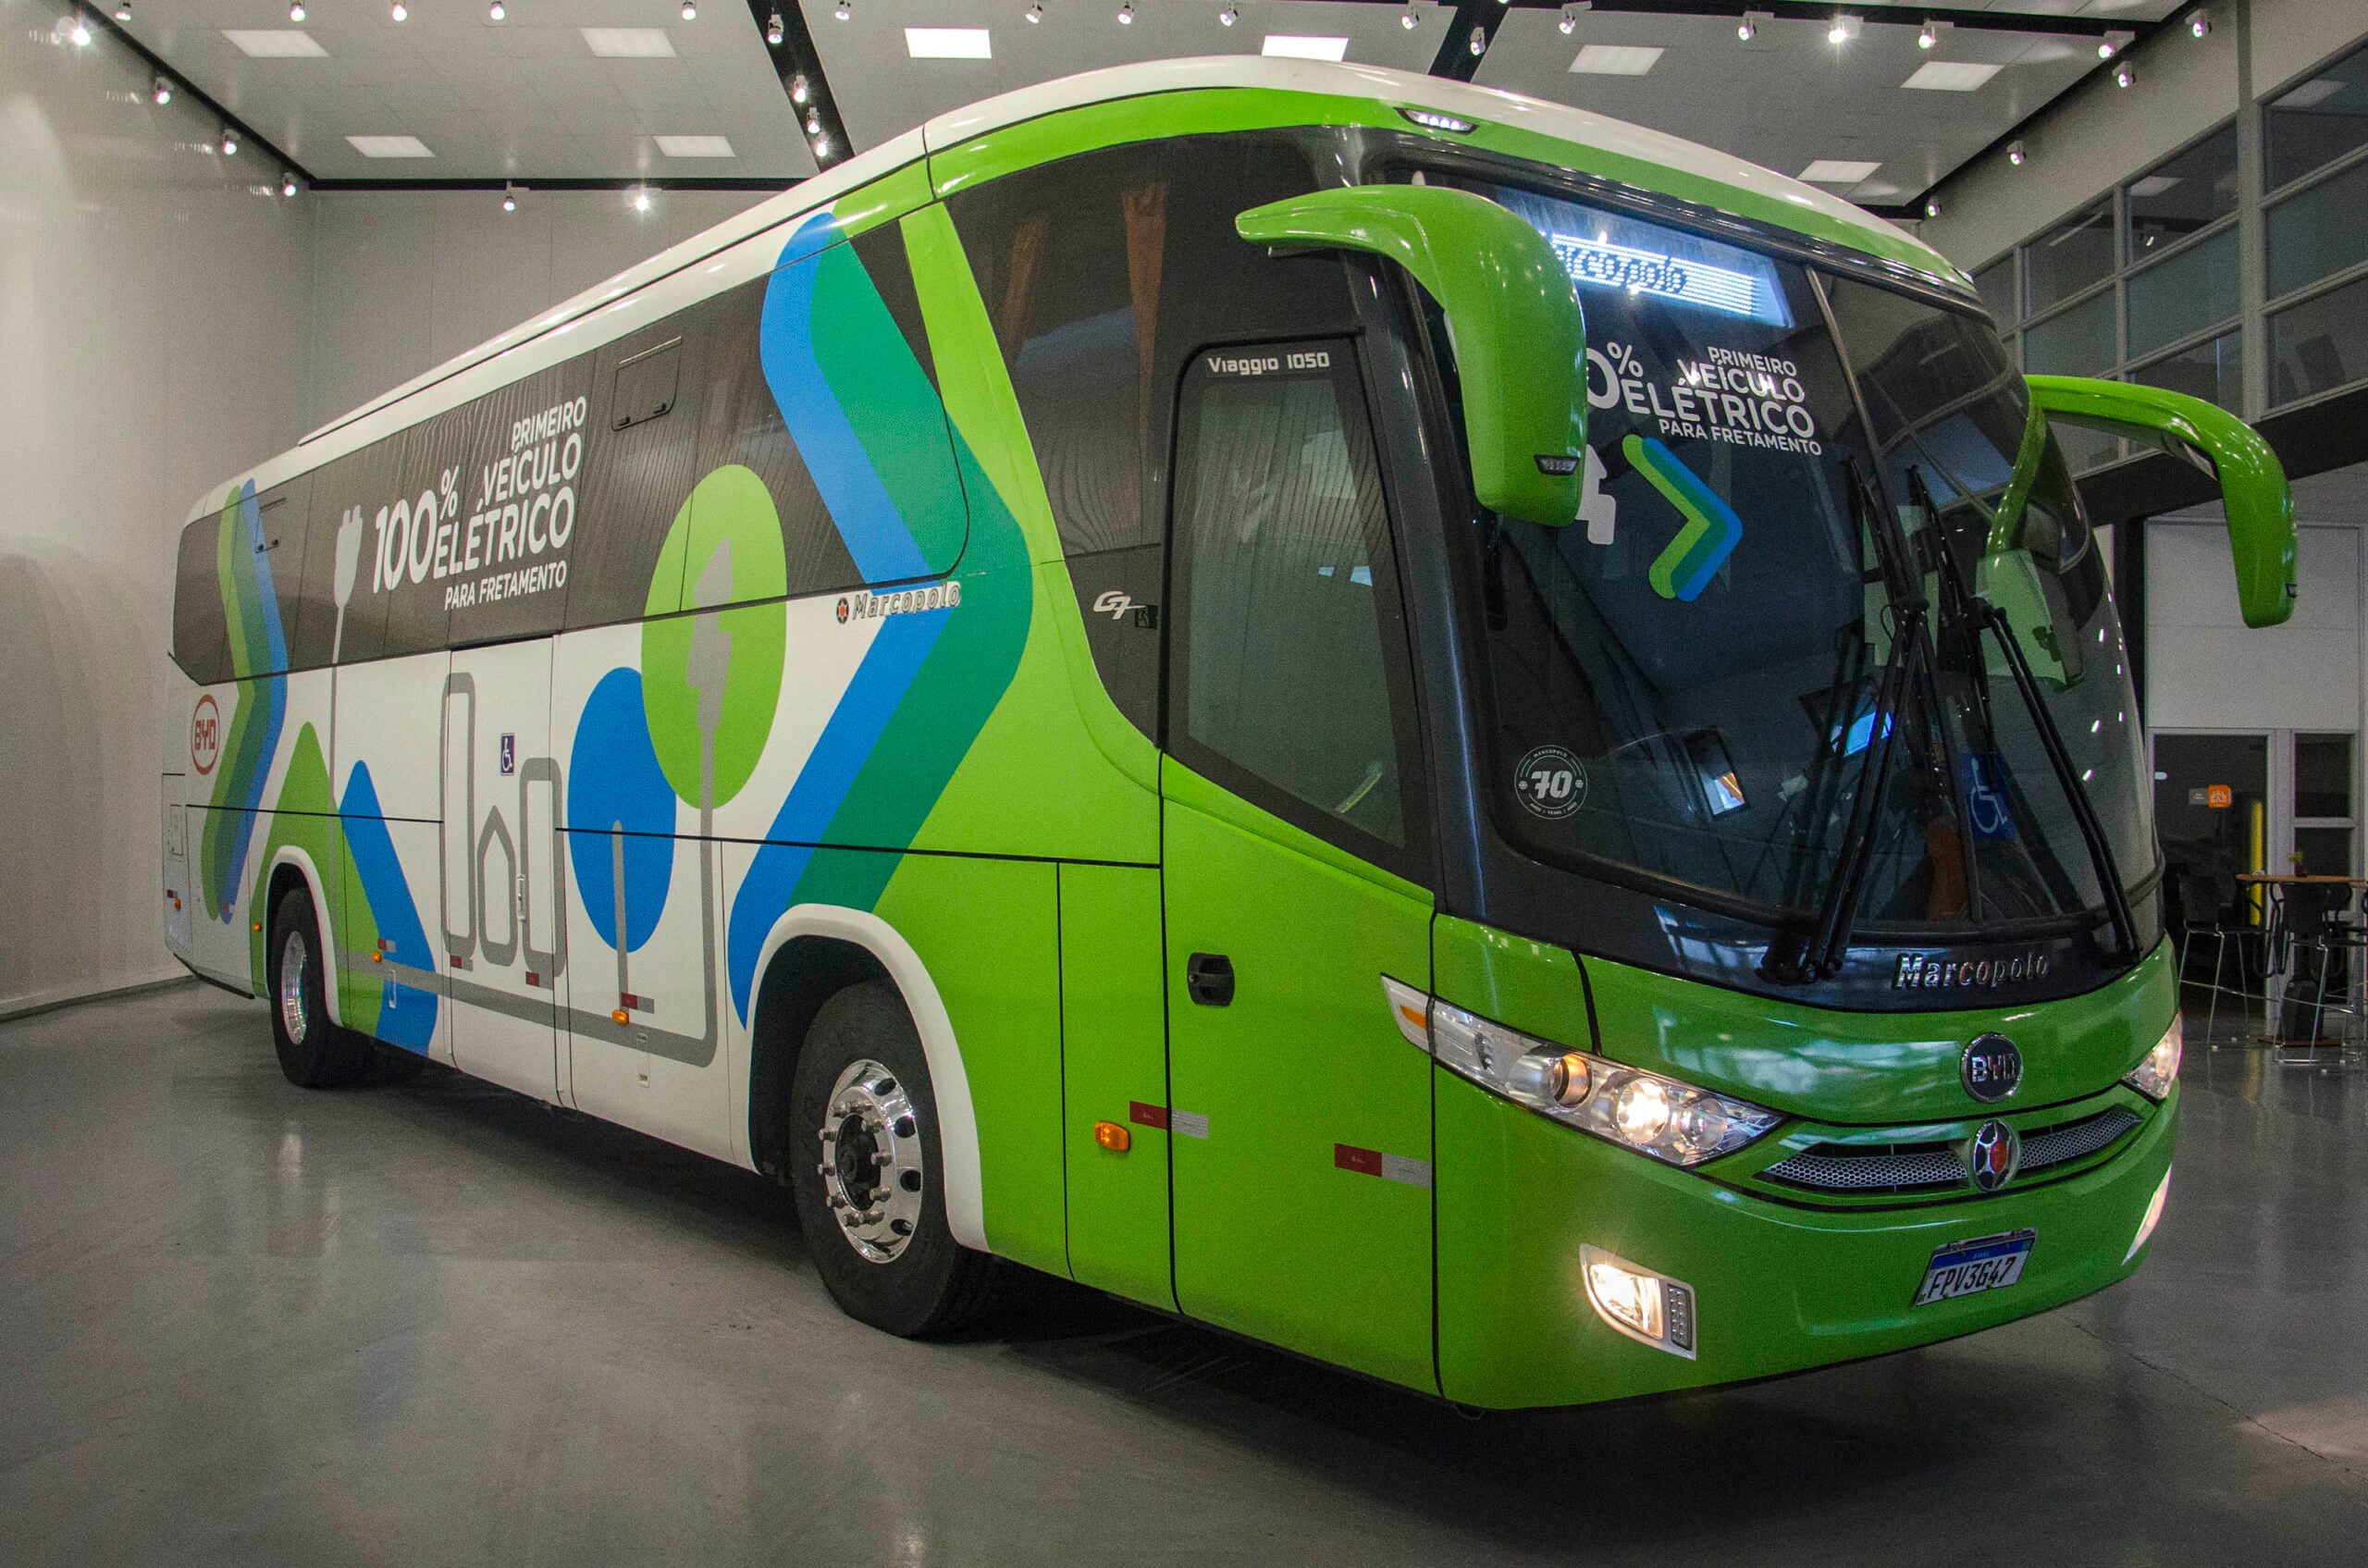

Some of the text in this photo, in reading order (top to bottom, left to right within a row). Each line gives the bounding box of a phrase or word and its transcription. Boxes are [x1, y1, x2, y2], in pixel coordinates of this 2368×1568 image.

[1207, 352, 1330, 376] Viaggio 1050
[1677, 358, 1805, 403] VEÍCULO
[1708, 346, 1797, 377] PRIMEIRO
[511, 396, 587, 451] PRIMEIRO
[1621, 376, 1815, 438] ELÉTRICO
[1659, 418, 1821, 456] PARA FRETAMENTO
[484, 432, 583, 506] VEÍCULO
[433, 486, 575, 579] ELÉTRICO
[444, 560, 567, 611] PARA FRETAMENTO
[852, 582, 961, 620] Marcopolo
[194, 718, 216, 751] BYD
[1531, 770, 1573, 799] 70
[1896, 951, 2049, 988] Marcopolo
[1971, 1053, 2016, 1083] BYD
[1927, 1255, 2017, 1300] FPV3G47
